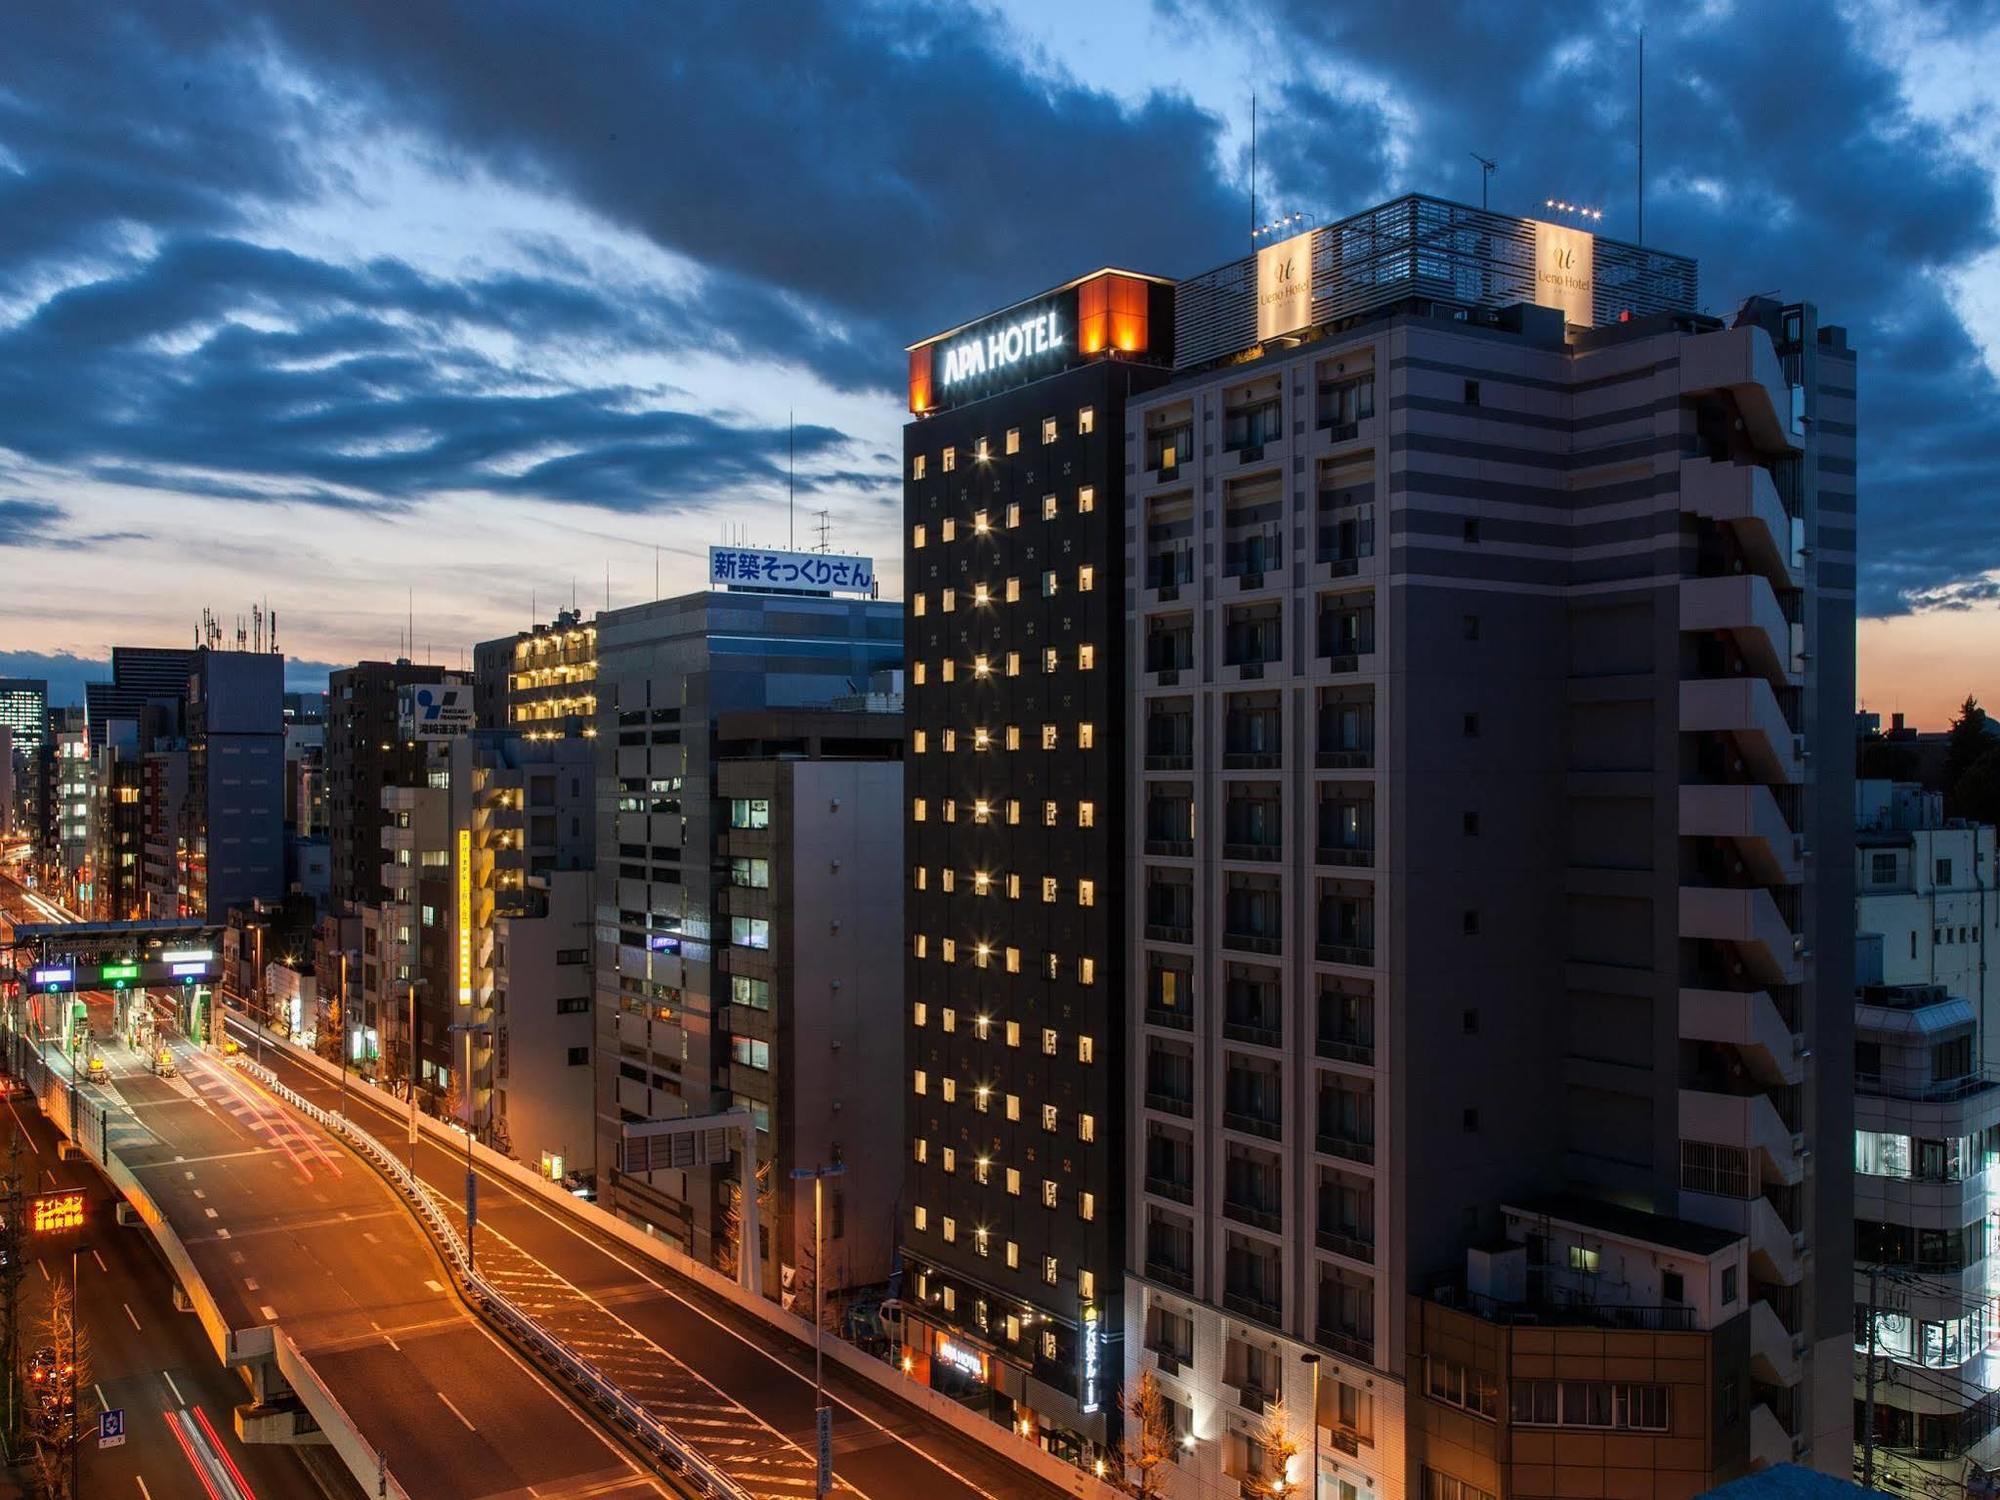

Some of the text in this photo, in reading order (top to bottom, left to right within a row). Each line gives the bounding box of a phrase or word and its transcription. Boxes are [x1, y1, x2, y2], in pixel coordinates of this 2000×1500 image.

[1260, 289, 1284, 306] Ueno
[1285, 279, 1309, 297] Hotel
[1538, 269, 1590, 291] Ueno Hotel
[943, 312, 1063, 385] APA HOTEL
[714, 551, 871, 588] 新築そっくりさん
